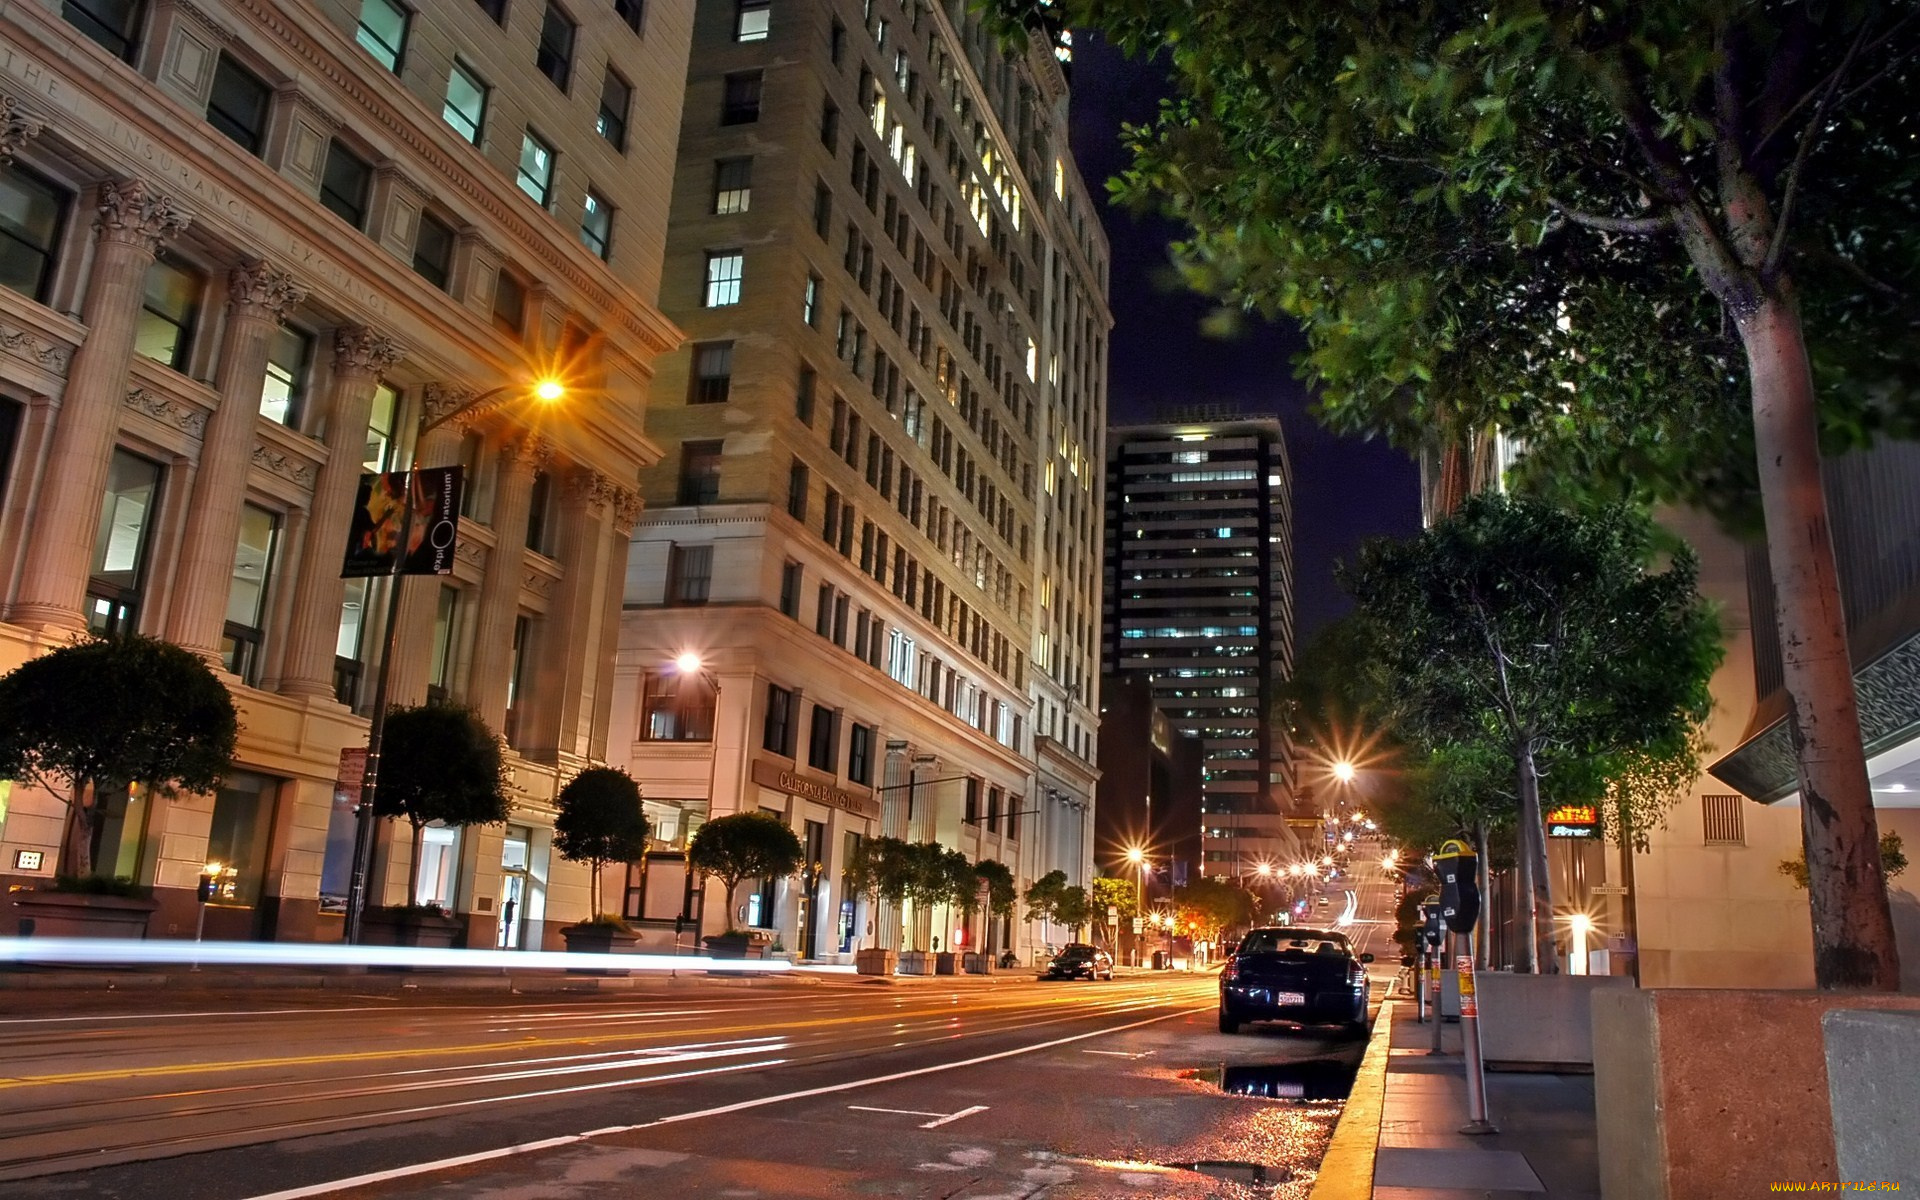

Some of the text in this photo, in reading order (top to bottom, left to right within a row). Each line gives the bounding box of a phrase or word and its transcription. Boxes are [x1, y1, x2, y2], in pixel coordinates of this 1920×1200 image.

[4, 48, 390, 316] THE INSURANCE EXCHANGE
